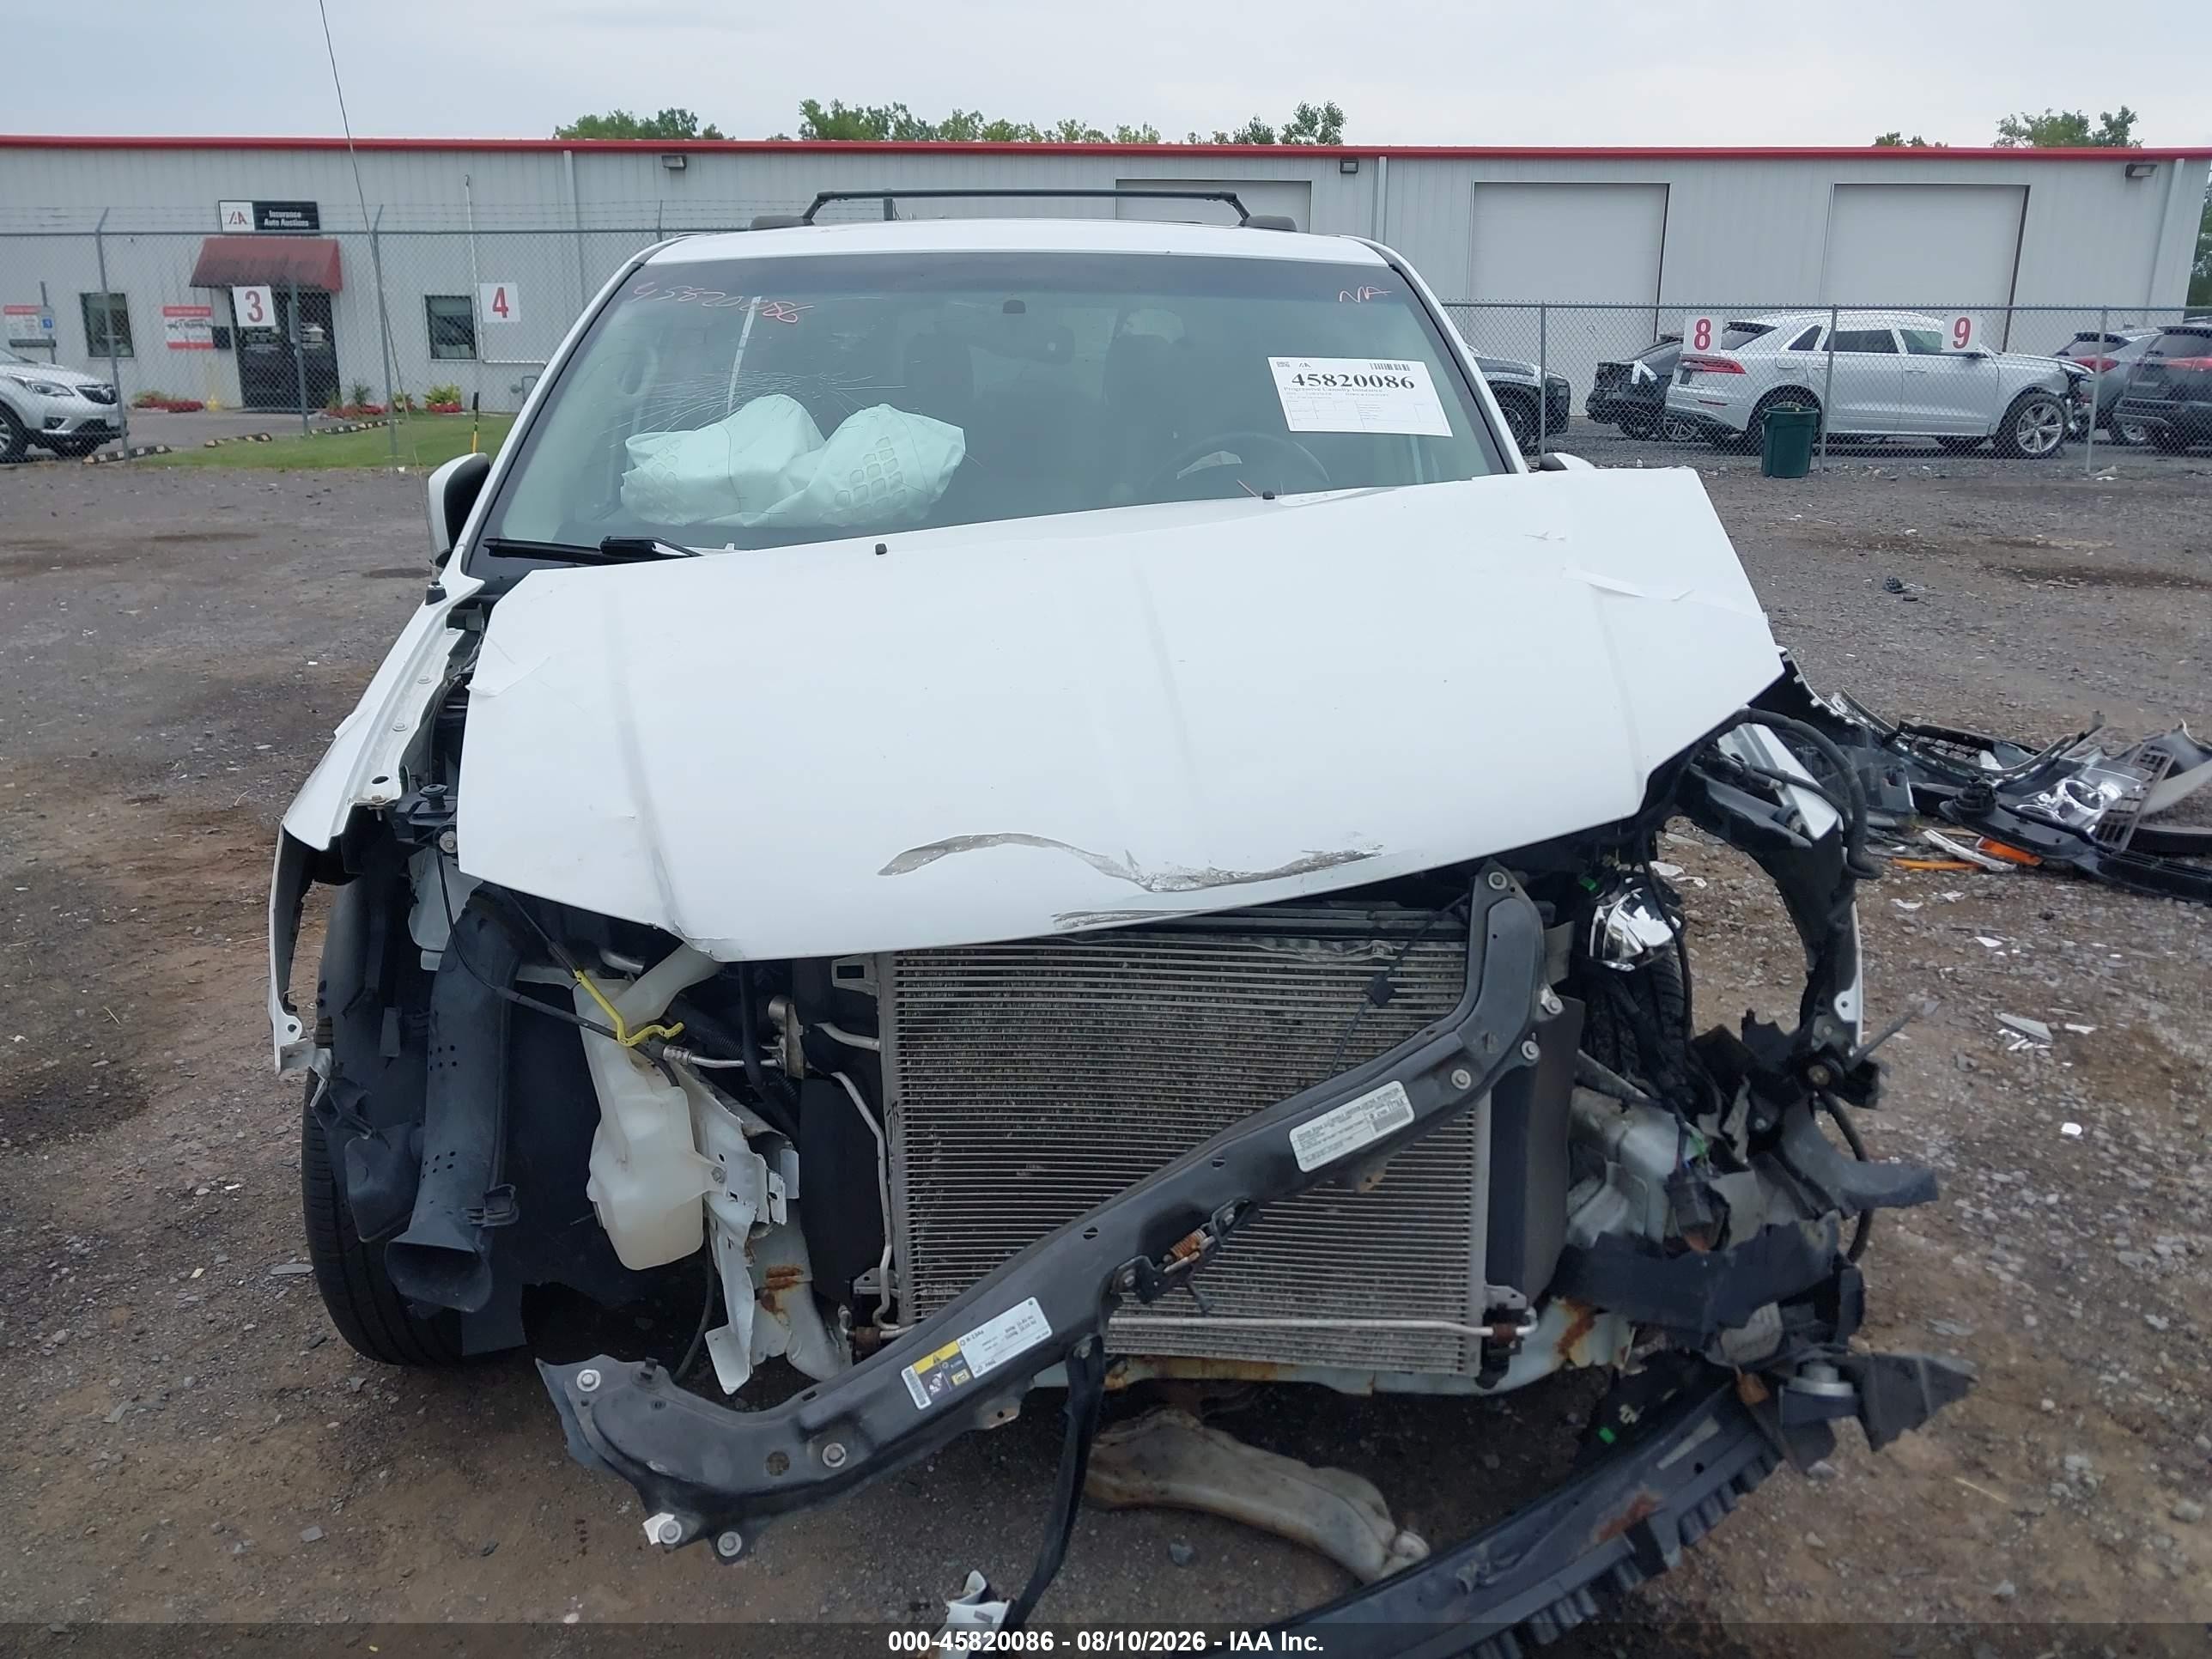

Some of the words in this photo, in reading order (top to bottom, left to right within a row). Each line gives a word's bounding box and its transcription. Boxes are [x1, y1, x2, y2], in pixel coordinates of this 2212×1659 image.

[264, 218, 280, 227] Auto
[280, 219, 309, 228] Auctions
[245, 289, 264, 323] 3
[492, 287, 509, 319] 4
[1693, 318, 1711, 350] 8
[1952, 316, 1972, 349] 9
[1291, 373, 1415, 390] 45820086
